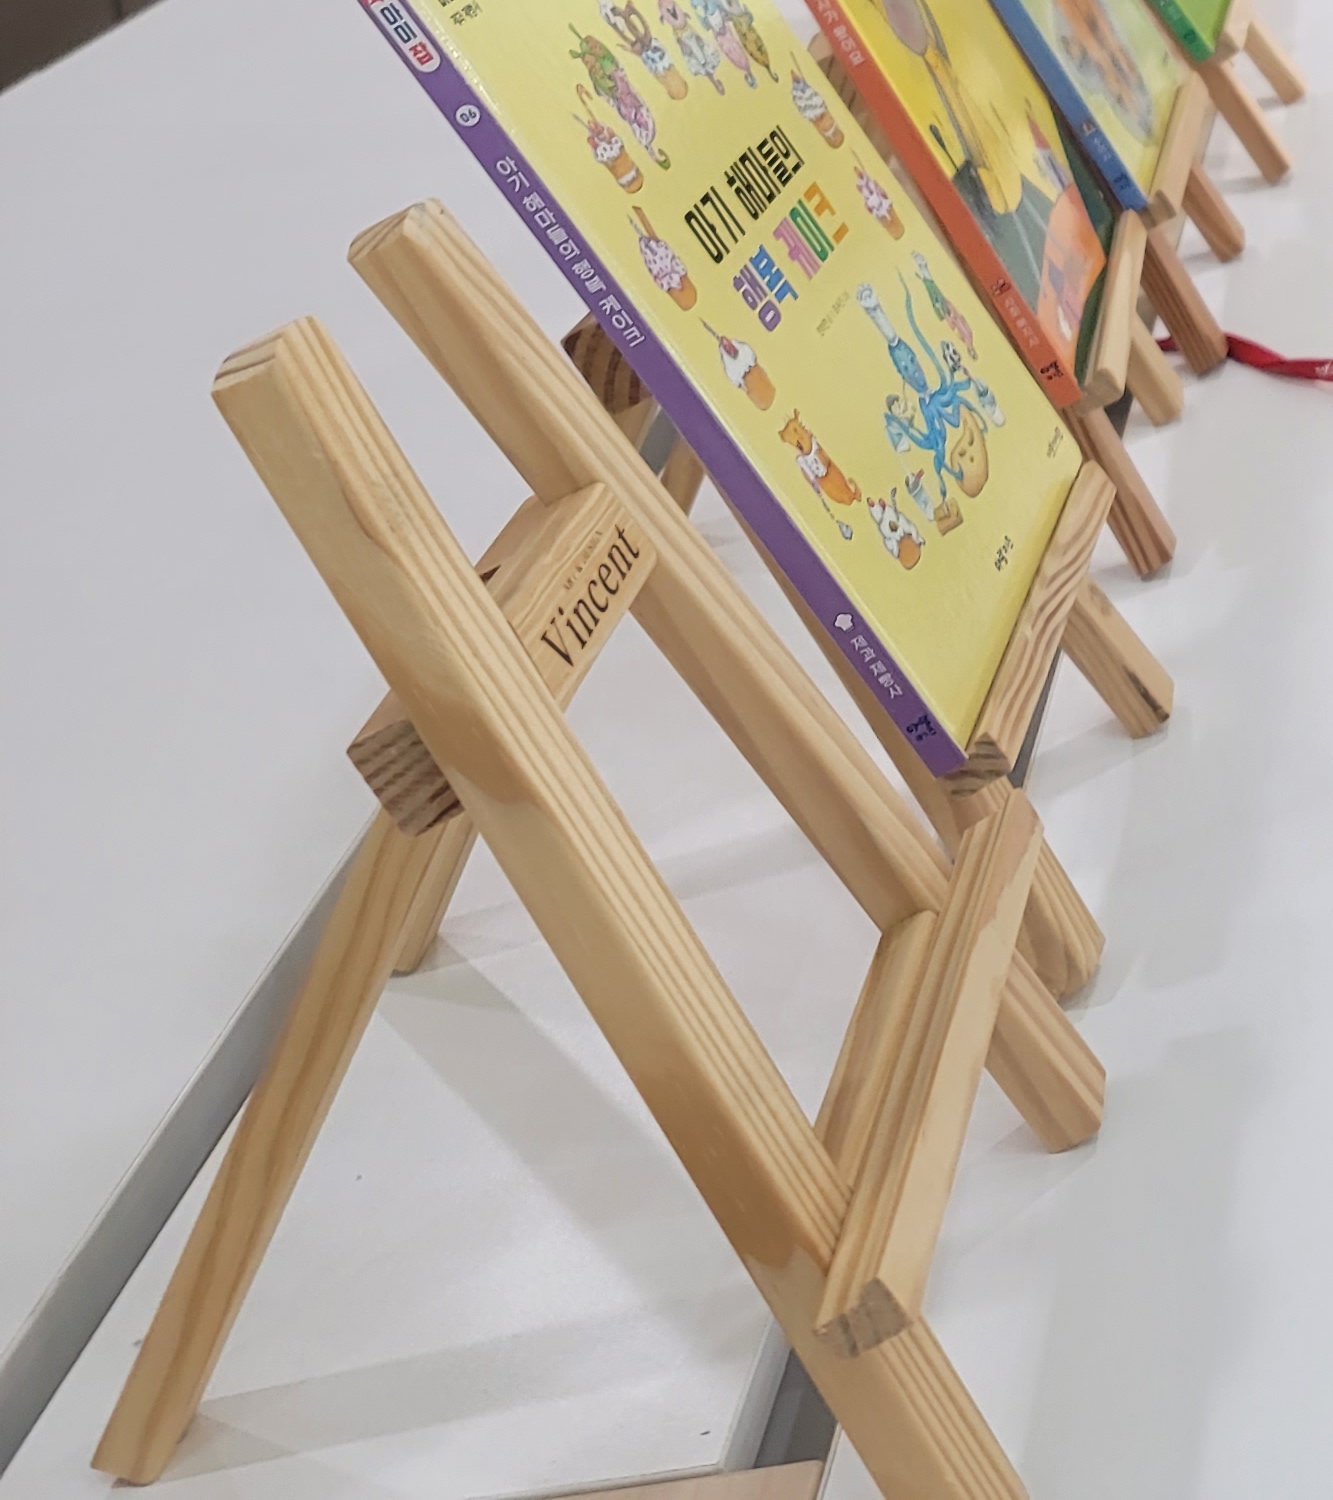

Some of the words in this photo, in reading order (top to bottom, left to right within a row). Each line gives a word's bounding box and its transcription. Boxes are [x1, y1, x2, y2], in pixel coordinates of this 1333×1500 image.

[459, 107, 477, 123] 06
[496, 156, 529, 192] 아기
[522, 192, 580, 260] 해마들의
[572, 258, 606, 294] 행복
[598, 294, 645, 348] 케이크
[684, 185, 745, 264] 아기
[724, 125, 805, 221] 해마들의
[733, 244, 799, 332] 행복
[772, 181, 849, 281] 케이크
[541, 524, 639, 667] Vincent
[850, 634, 876, 663] 제과
[868, 661, 904, 700] 제빵사
